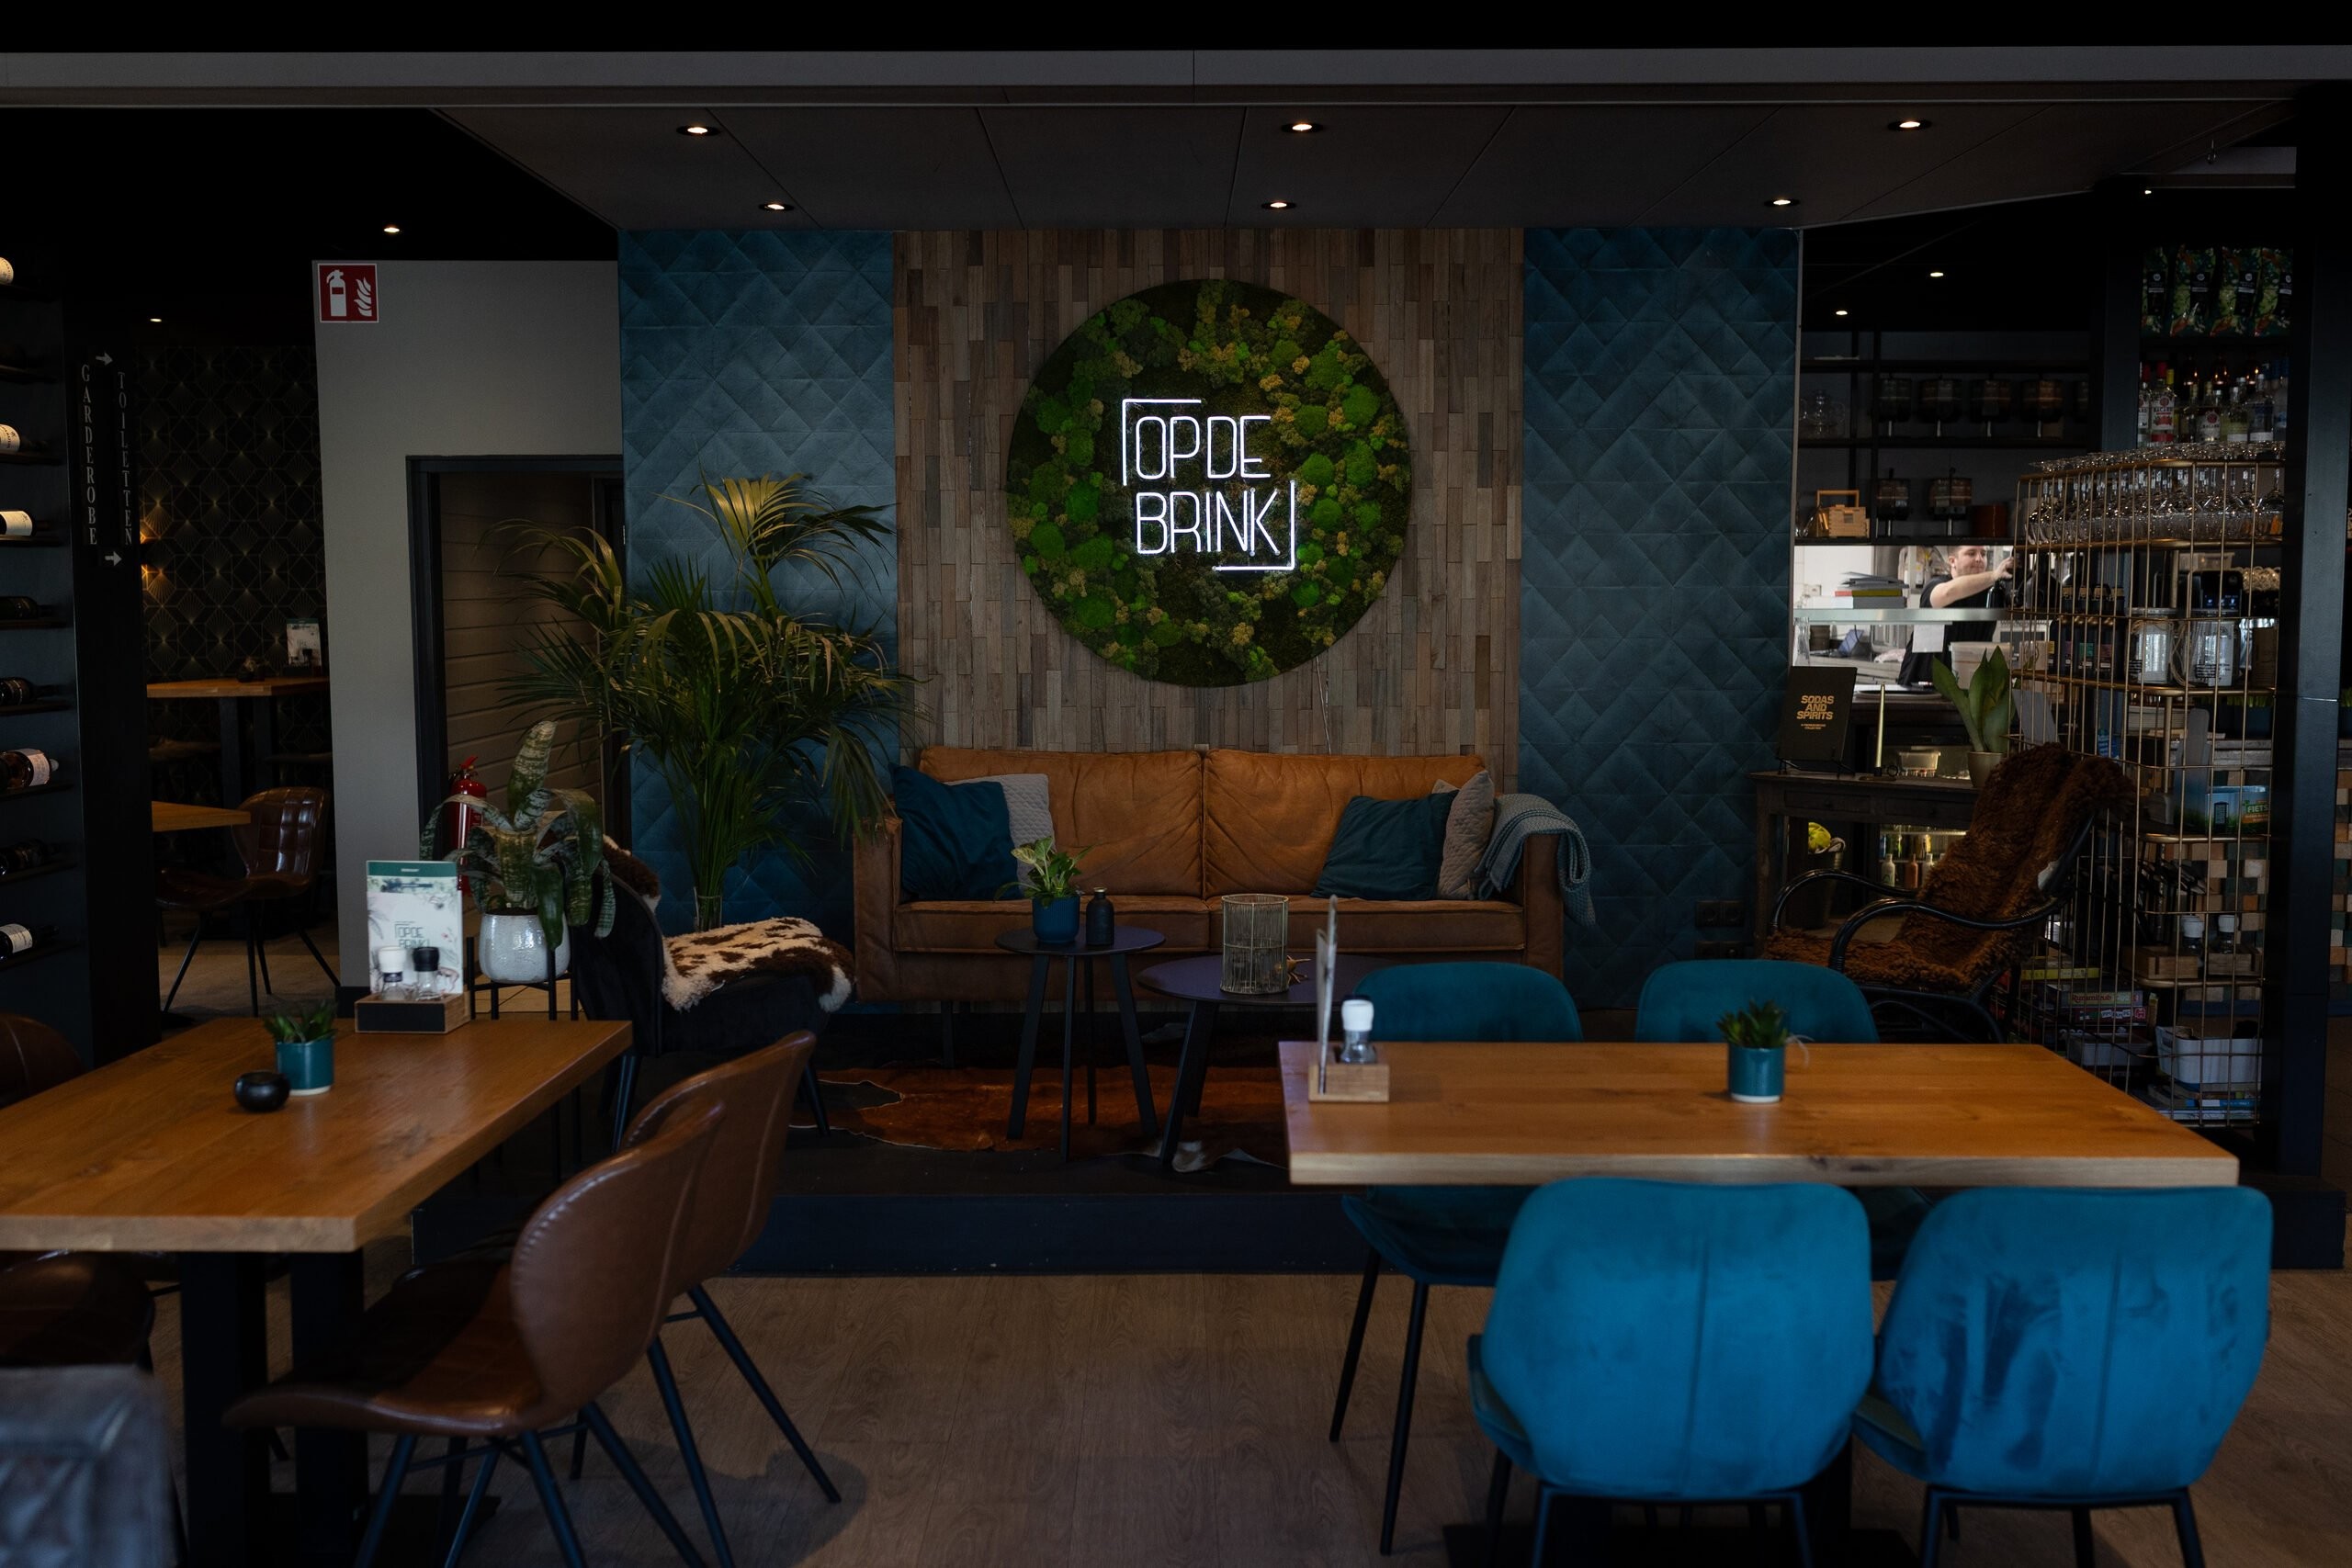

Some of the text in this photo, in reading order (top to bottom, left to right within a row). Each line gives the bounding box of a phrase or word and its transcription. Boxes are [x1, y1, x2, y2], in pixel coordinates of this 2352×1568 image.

[81, 364, 97, 546] GARDEROBE
[117, 371, 133, 546] TOILETTEN
[1136, 416, 1272, 479] OP DE
[1136, 489, 1282, 556] BRINK
[1796, 710, 1835, 720] SPIRITS
[1801, 694, 1835, 705] SODAS
[1805, 704, 1827, 712] AND
